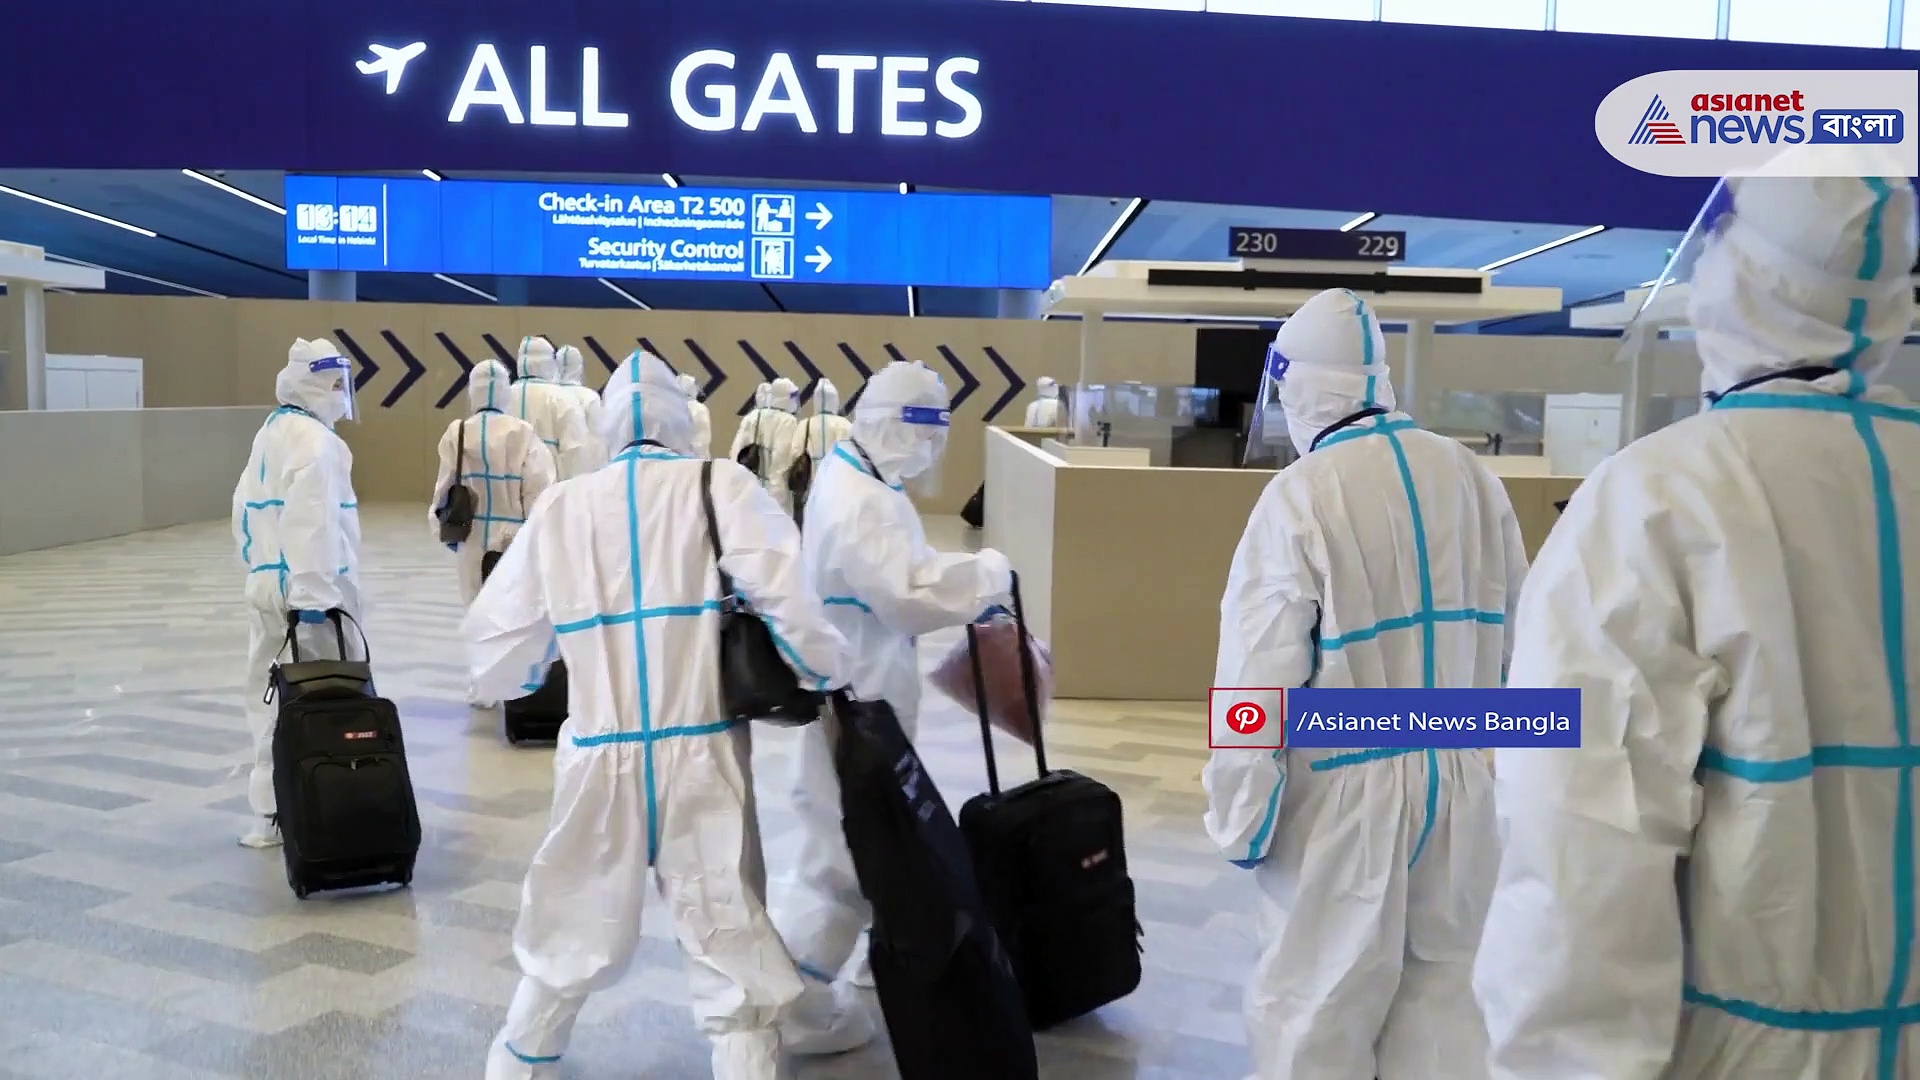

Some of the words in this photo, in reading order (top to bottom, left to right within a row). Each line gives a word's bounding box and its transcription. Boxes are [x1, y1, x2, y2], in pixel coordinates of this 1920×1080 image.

[447, 43, 629, 128] ALL
[669, 49, 983, 139] GATES
[538, 191, 623, 214] Check-in
[627, 195, 675, 214] Area
[680, 196, 704, 215] T2
[709, 197, 745, 216] 500
[588, 237, 667, 260] Security
[670, 240, 744, 259] Control
[1236, 232, 1278, 253] 230
[1357, 236, 1399, 257] 229
